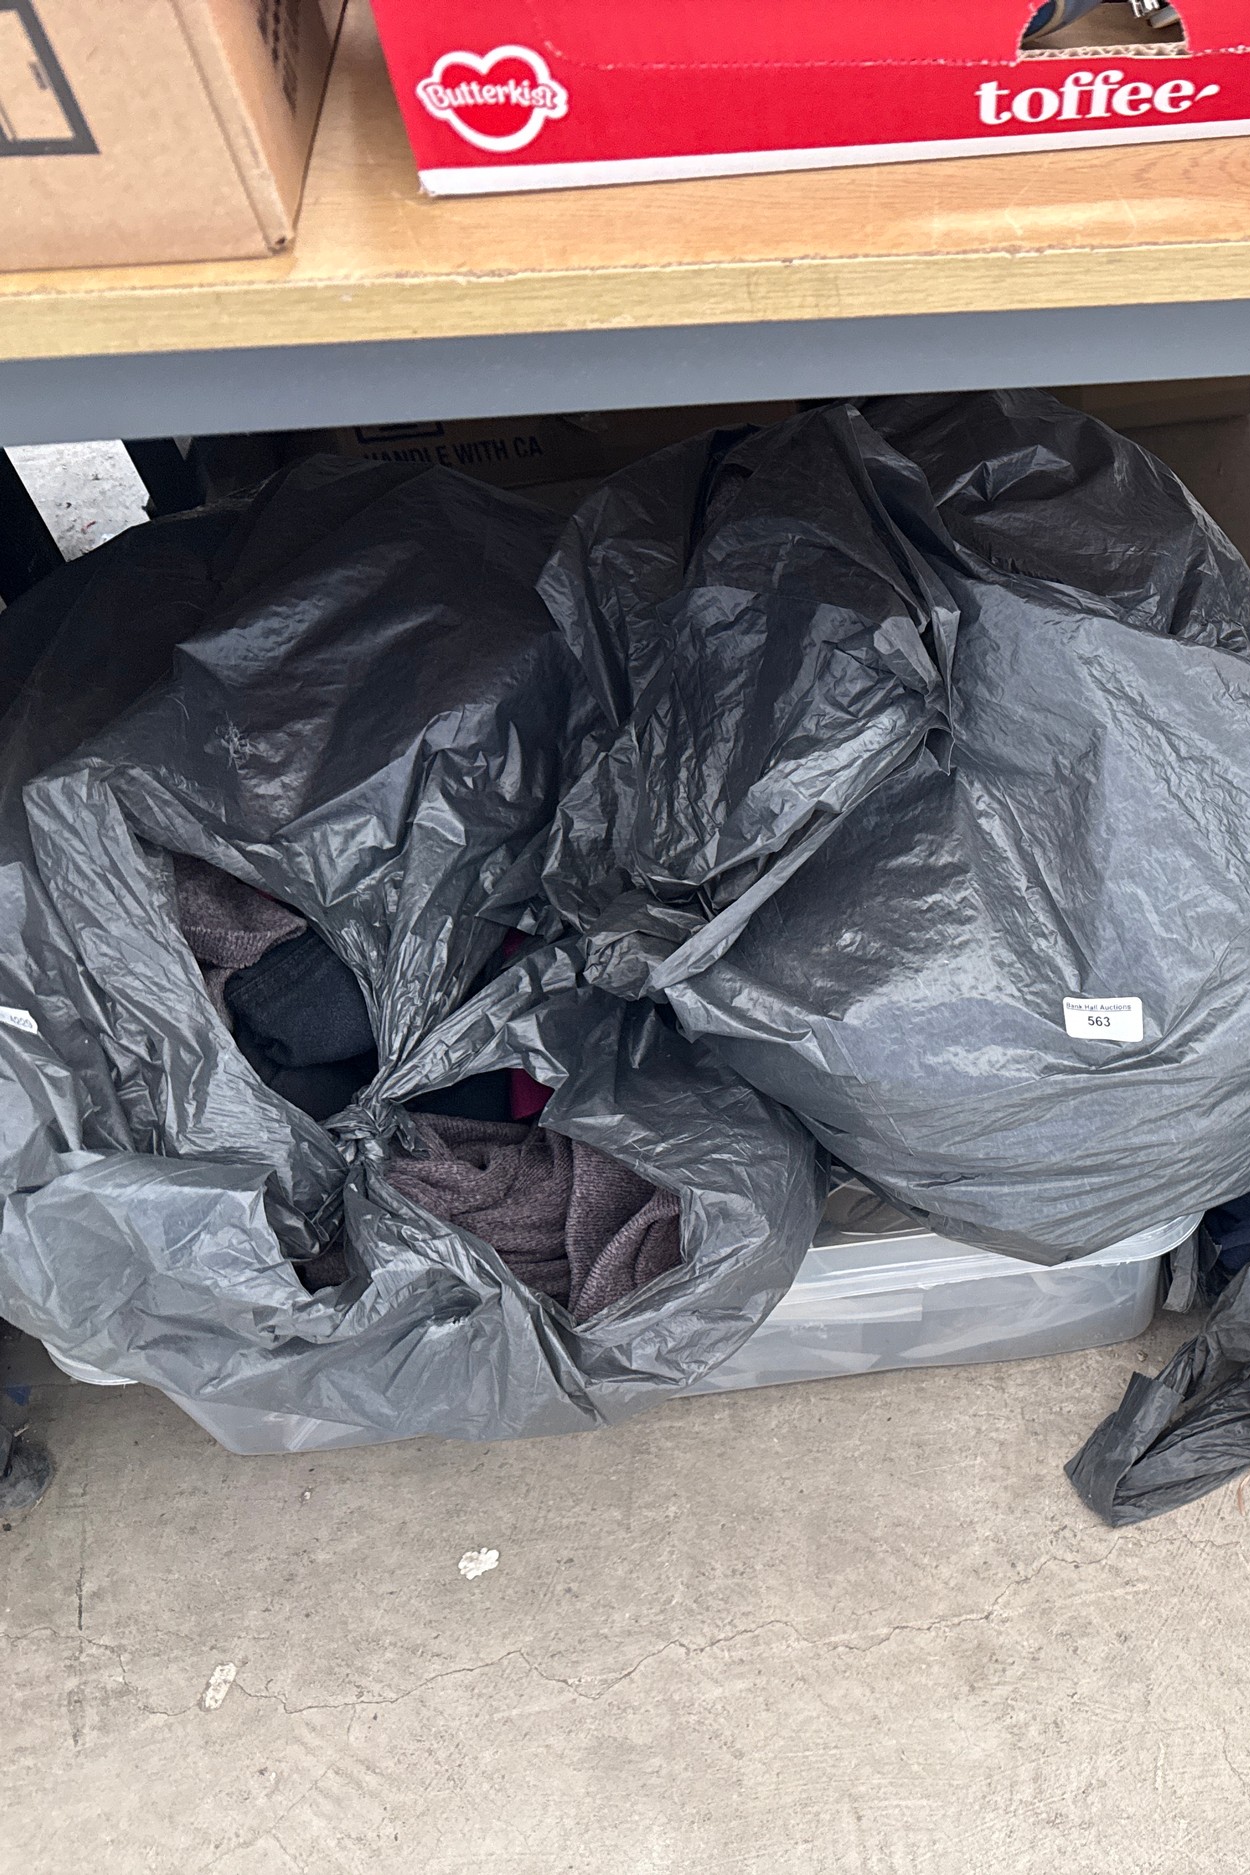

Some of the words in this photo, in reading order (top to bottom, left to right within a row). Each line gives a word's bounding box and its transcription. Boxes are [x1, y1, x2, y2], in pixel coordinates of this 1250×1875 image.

[426, 78, 557, 109] Butterkist
[974, 69, 1220, 125] toffee
[363, 444, 453, 468] NDLE
[453, 438, 509, 465] WITH
[512, 435, 544, 459] CA
[1087, 1015, 1111, 1027] 563
